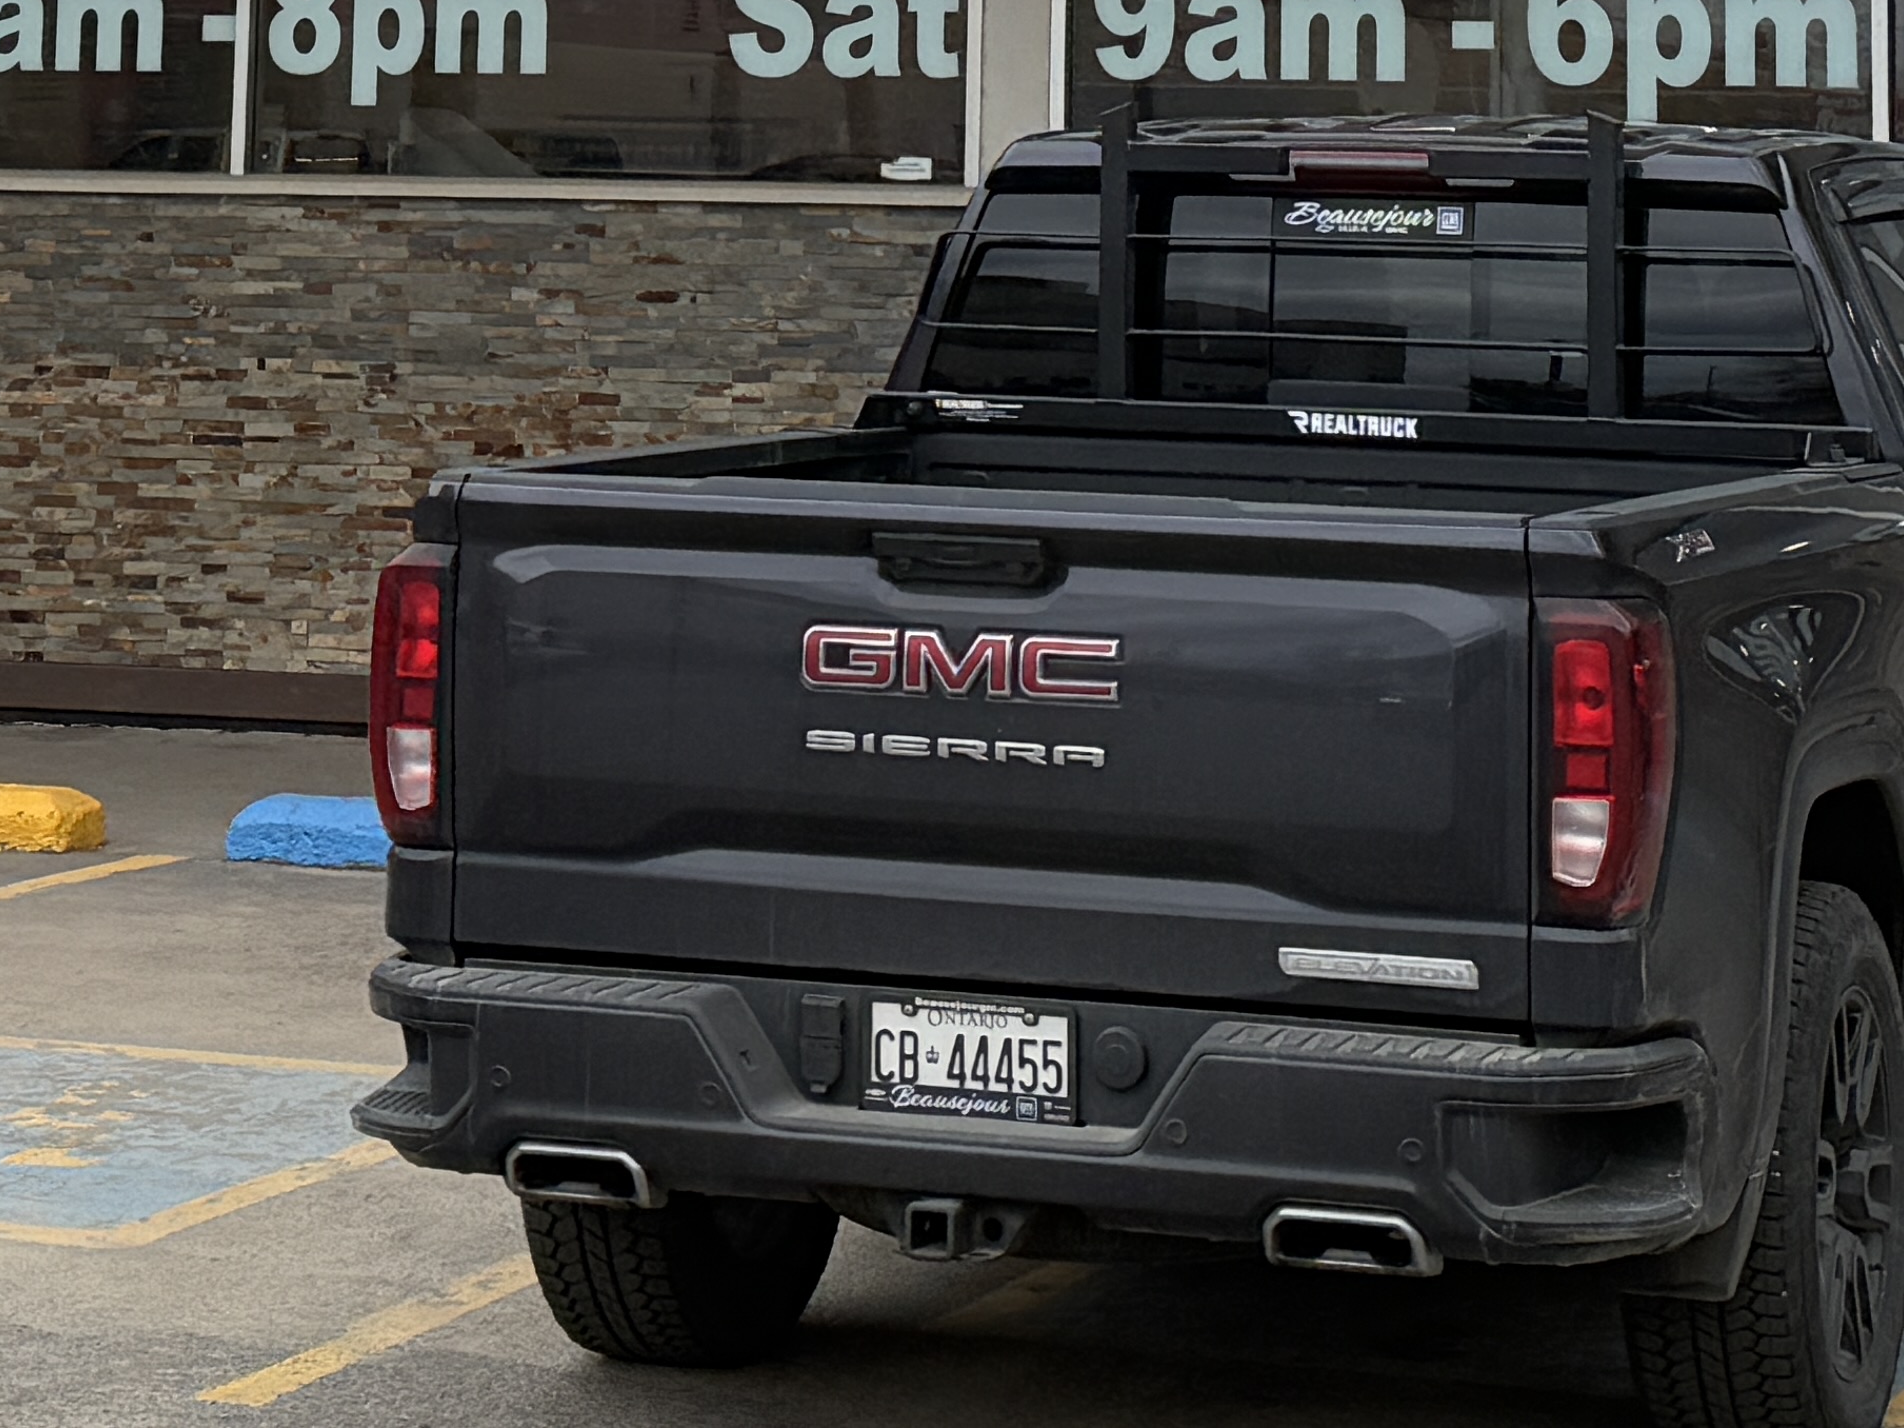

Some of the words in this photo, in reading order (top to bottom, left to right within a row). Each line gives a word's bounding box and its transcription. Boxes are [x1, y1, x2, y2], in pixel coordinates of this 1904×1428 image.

[1311, 412, 1418, 439] REALTRUCK
[802, 624, 1122, 704] GMC
[805, 729, 1106, 768] SIERRA
[1294, 956, 1466, 982] ELEVATION
[874, 1027, 920, 1085] CB
[946, 1032, 1063, 1095] 44455
